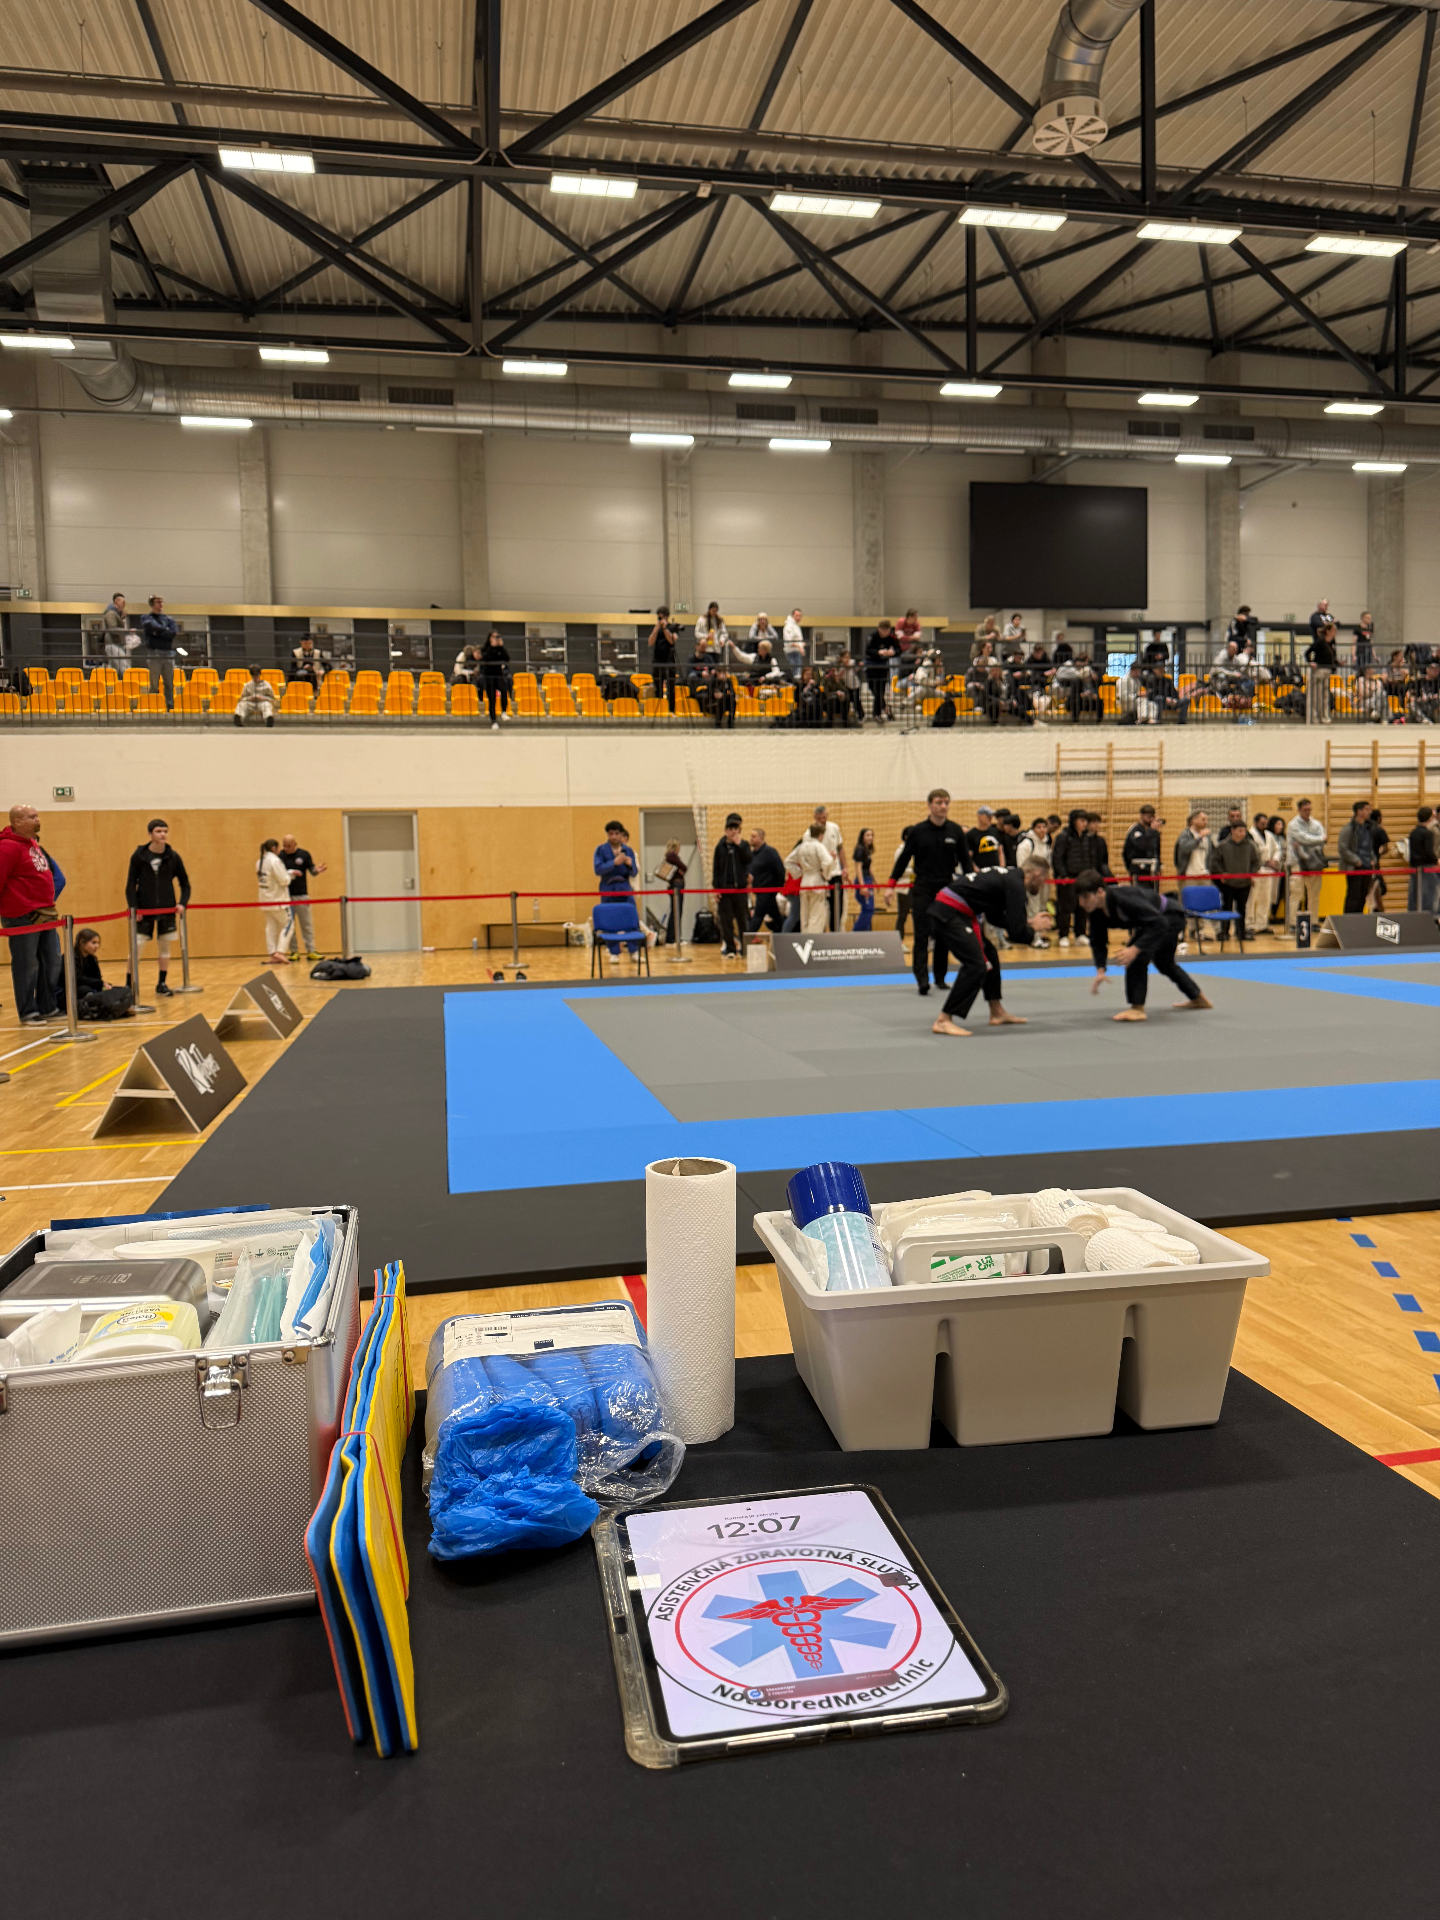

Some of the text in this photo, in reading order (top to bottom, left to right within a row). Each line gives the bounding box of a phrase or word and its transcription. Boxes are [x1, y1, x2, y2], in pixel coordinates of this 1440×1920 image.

[1300, 920, 1309, 940] 3
[707, 1515, 800, 1539] 12:07
[732, 1548, 854, 1564] ZDRAVOTNÁ
[857, 1557, 920, 1591] SLUA
